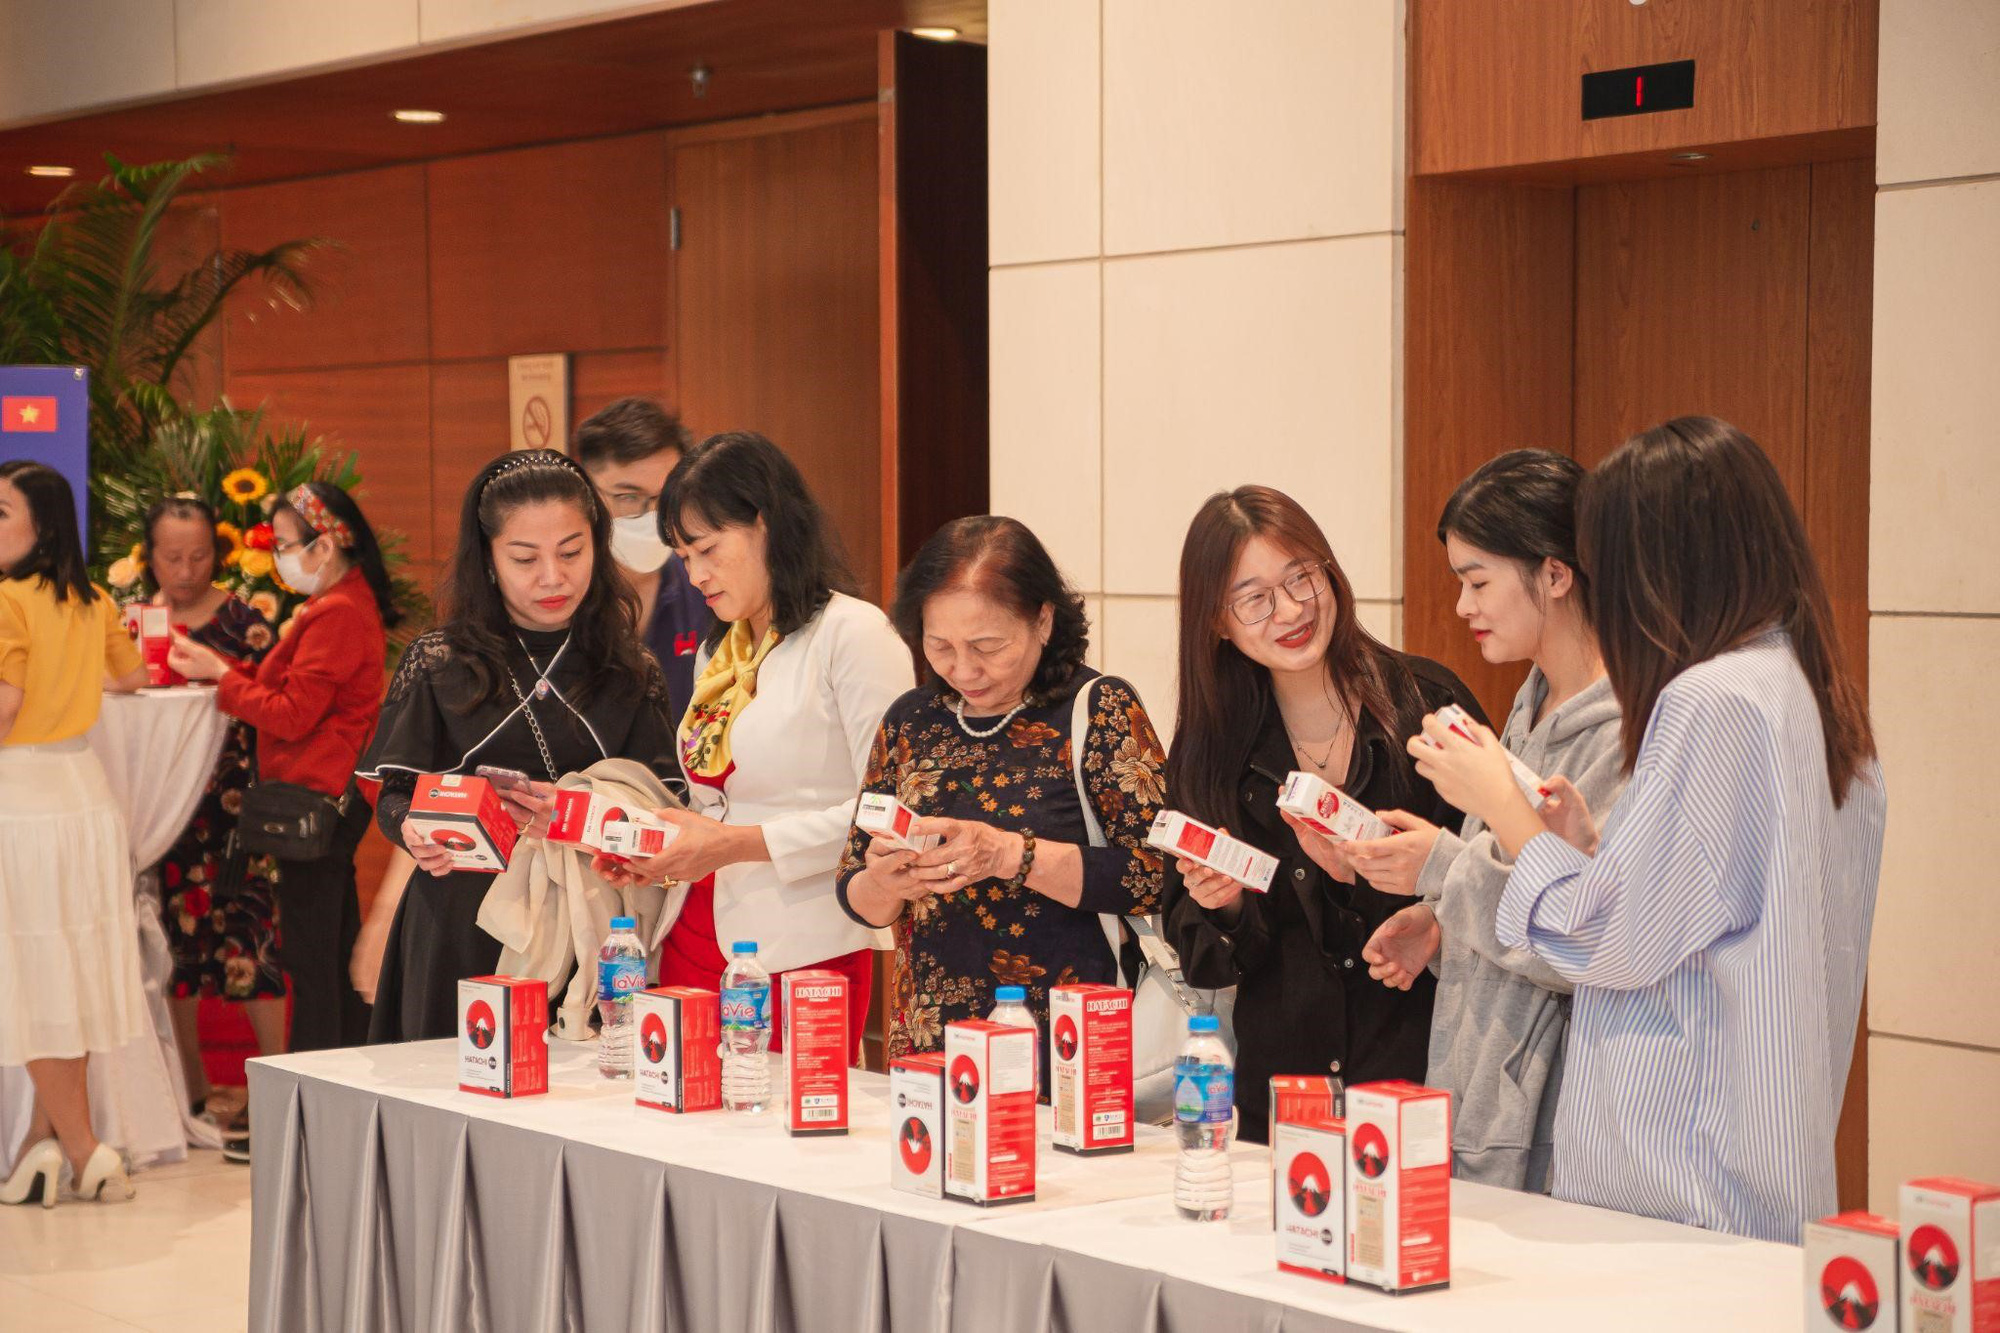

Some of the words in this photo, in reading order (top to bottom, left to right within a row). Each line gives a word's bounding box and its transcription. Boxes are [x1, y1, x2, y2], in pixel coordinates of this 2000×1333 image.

[613, 974, 646, 989] laVie
[795, 986, 842, 998] HATACHI
[1086, 999, 1128, 1012] HATACHI
